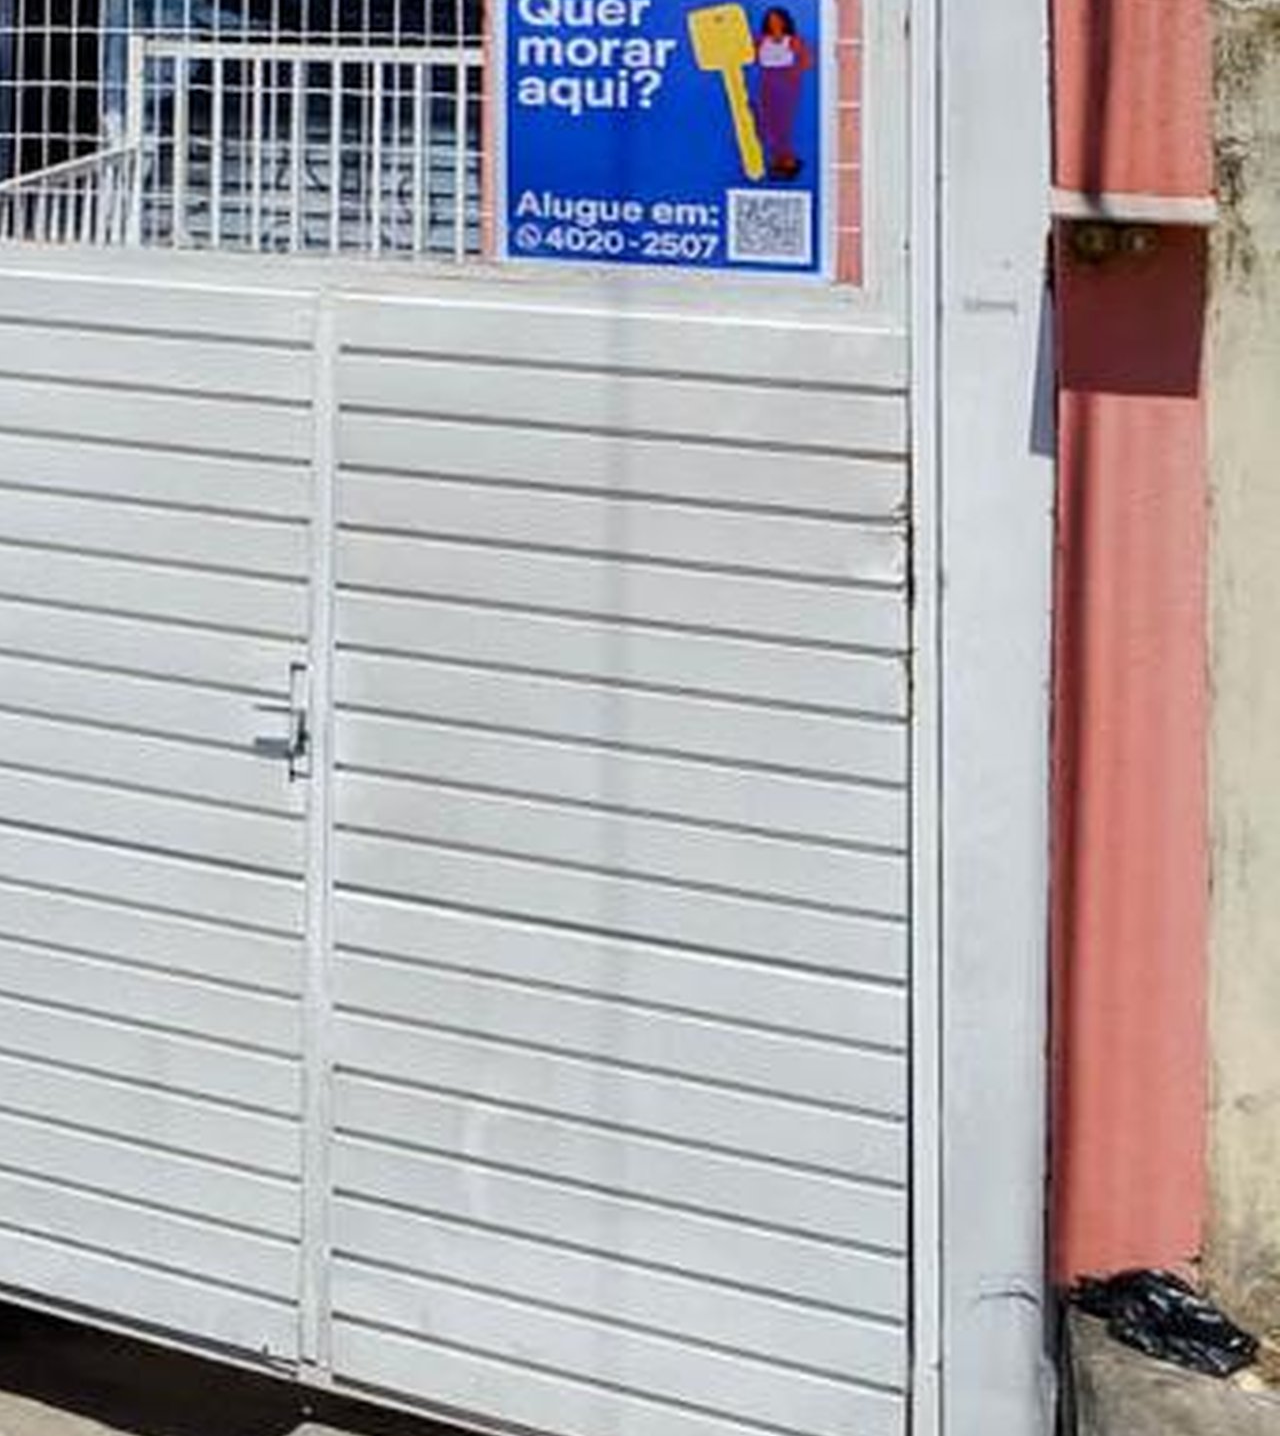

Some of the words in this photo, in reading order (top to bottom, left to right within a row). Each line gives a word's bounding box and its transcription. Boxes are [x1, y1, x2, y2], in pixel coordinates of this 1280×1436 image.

[517, 35, 678, 68] morar
[517, 68, 662, 117] aqui?
[515, 189, 644, 228] Alugue
[651, 201, 720, 228] em:
